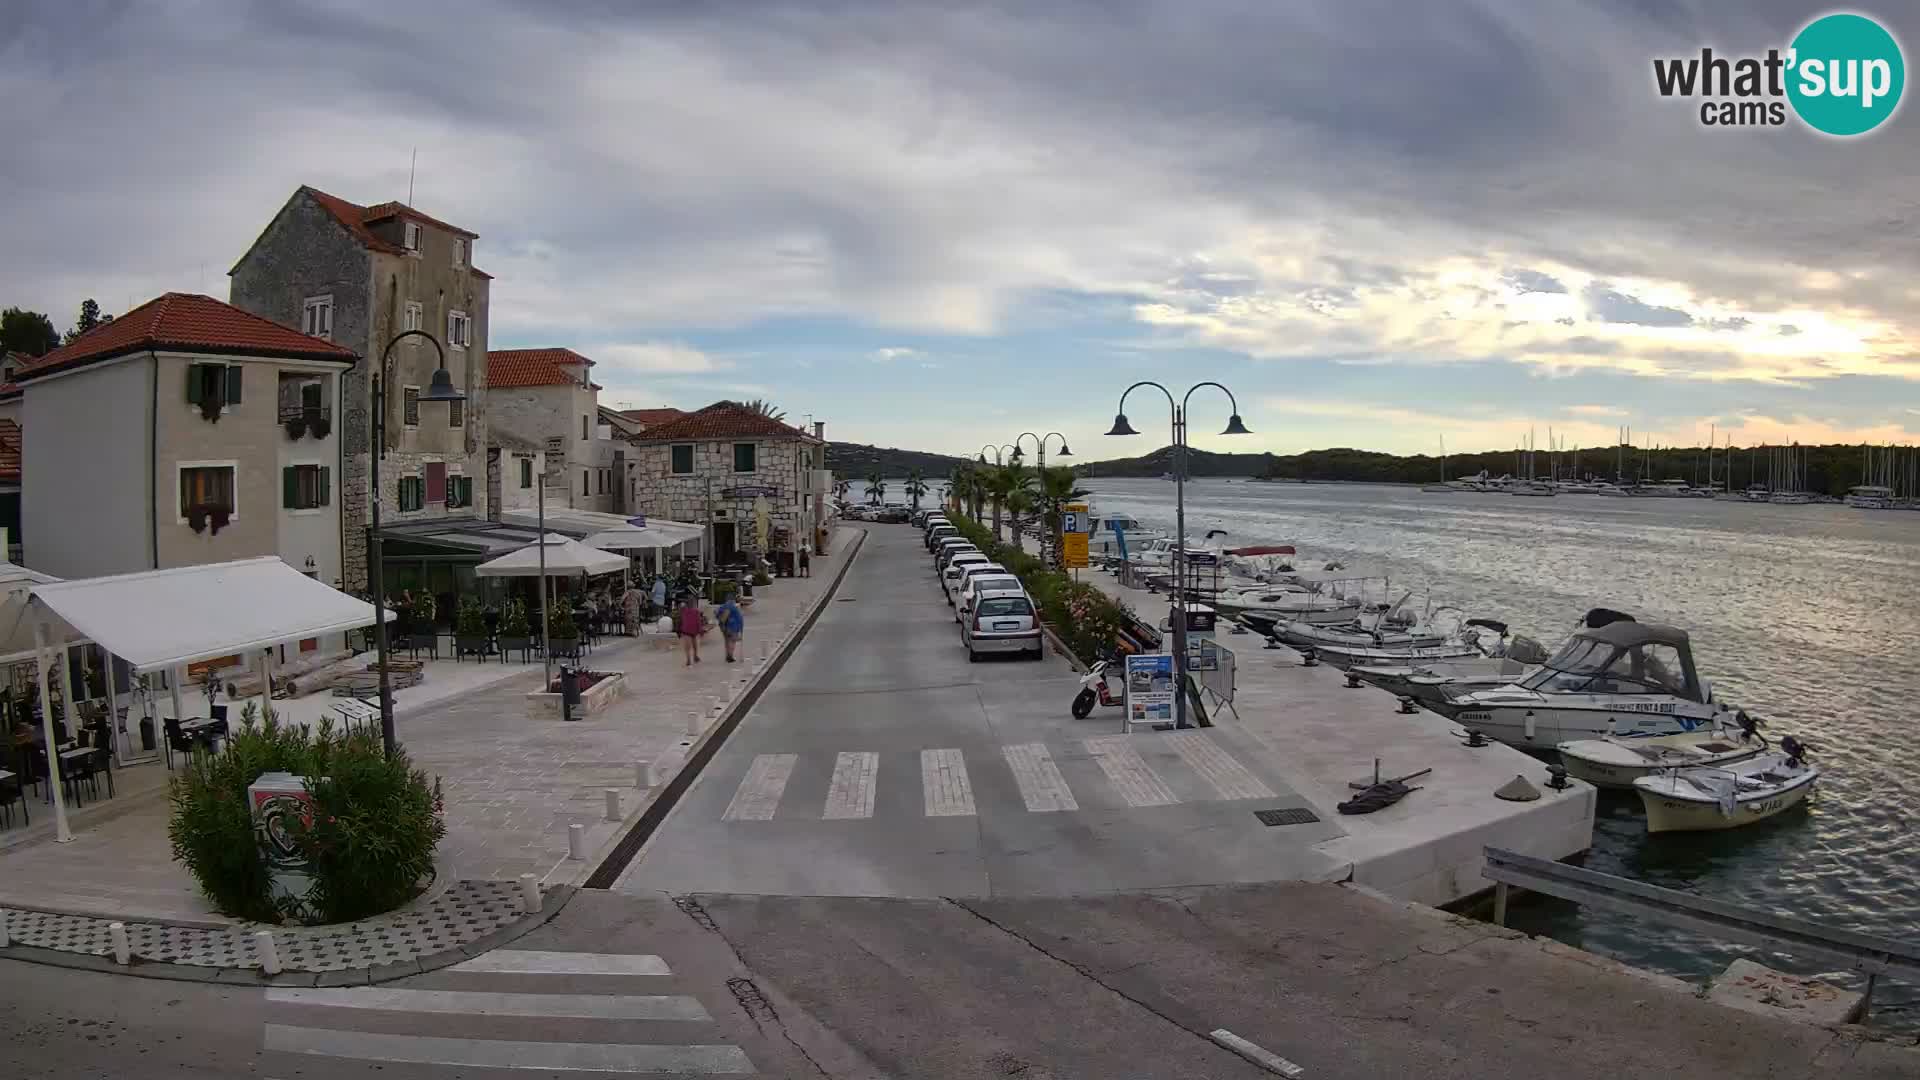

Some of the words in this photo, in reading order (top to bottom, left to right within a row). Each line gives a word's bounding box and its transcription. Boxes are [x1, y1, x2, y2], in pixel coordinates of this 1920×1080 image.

[1066, 514, 1076, 530] P
[1635, 703, 1653, 712] RENT
[1660, 703, 1676, 713] BOAT
